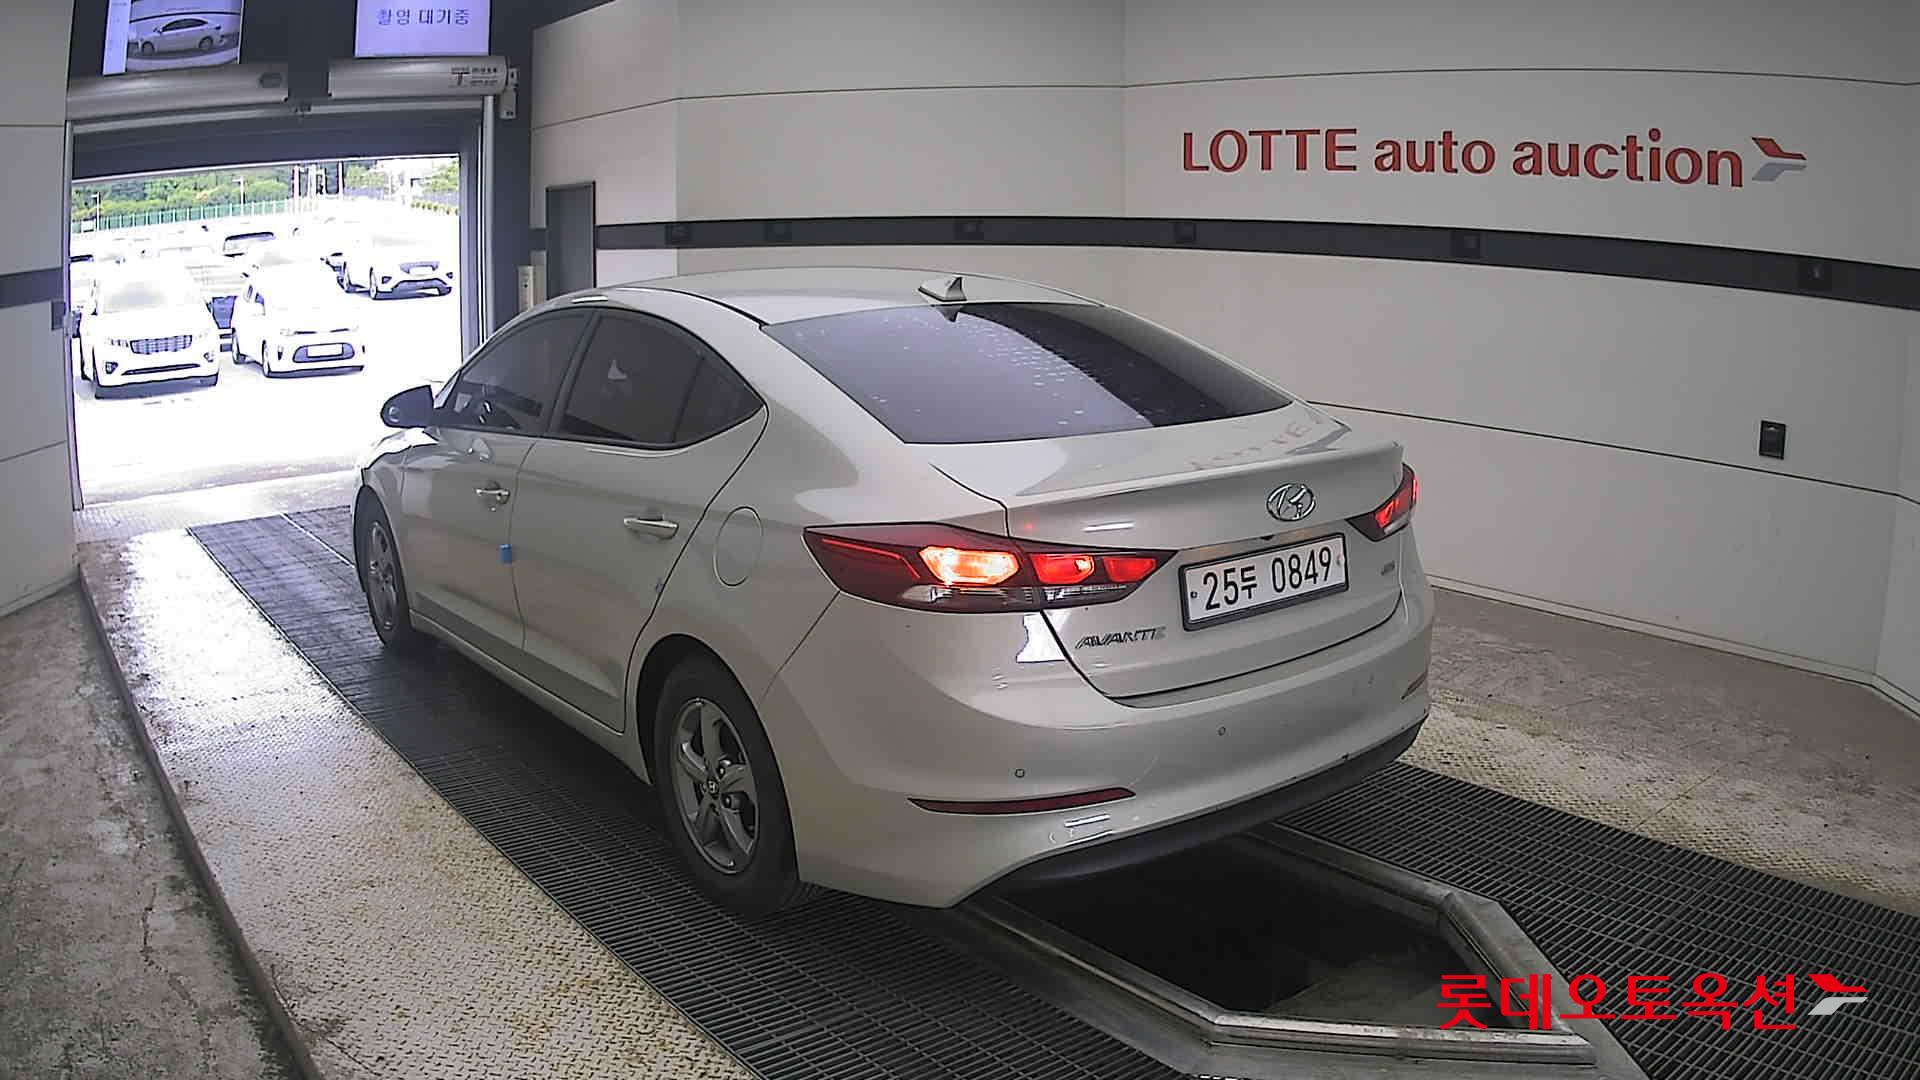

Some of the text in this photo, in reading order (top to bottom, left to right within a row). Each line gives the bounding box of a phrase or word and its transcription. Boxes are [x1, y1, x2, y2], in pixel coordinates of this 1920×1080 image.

[418, 8, 471, 25] 대기중
[1183, 127, 1744, 187] LOTTE auto auction
[1202, 546, 1332, 611] 25두 0849
[1074, 626, 1167, 649] AVANTE
